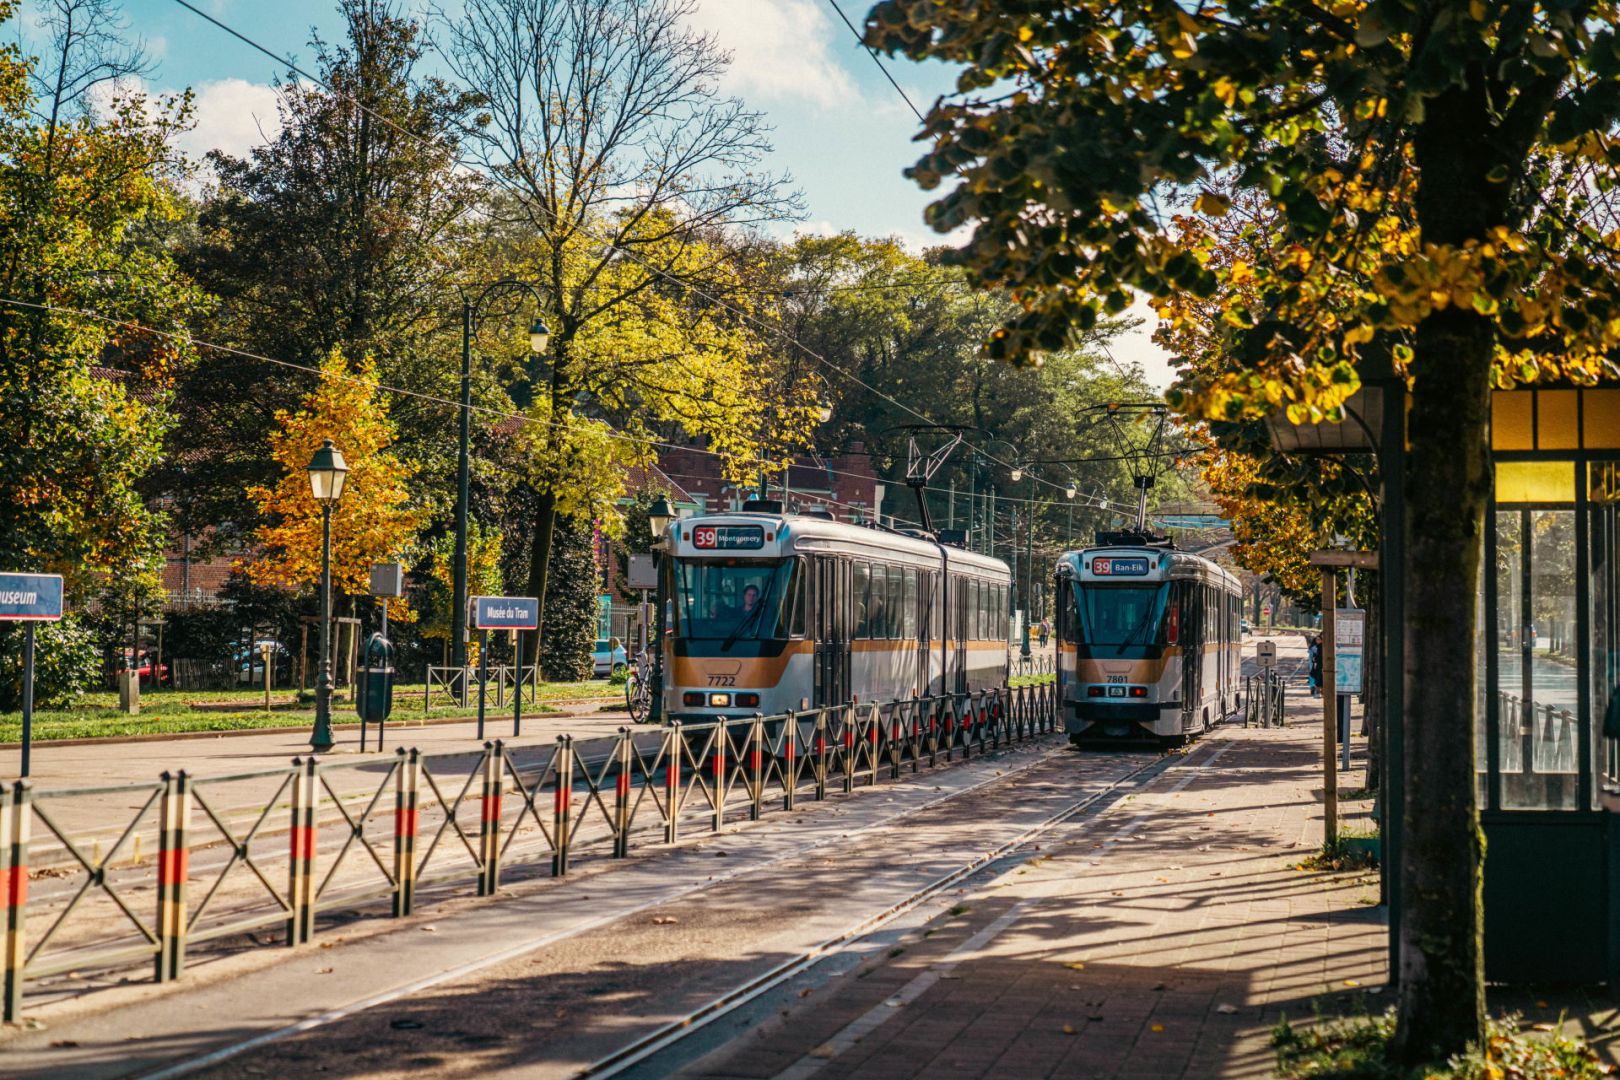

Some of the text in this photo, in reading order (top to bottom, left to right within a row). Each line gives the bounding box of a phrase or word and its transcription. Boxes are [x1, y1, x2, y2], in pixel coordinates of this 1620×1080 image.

[696, 531, 760, 545] 39 Montgomery
[1095, 561, 1110, 573] 39
[487, 605, 529, 619] Musée du Tram
[708, 676, 736, 687] 7722
[1106, 675, 1128, 684] 7801
